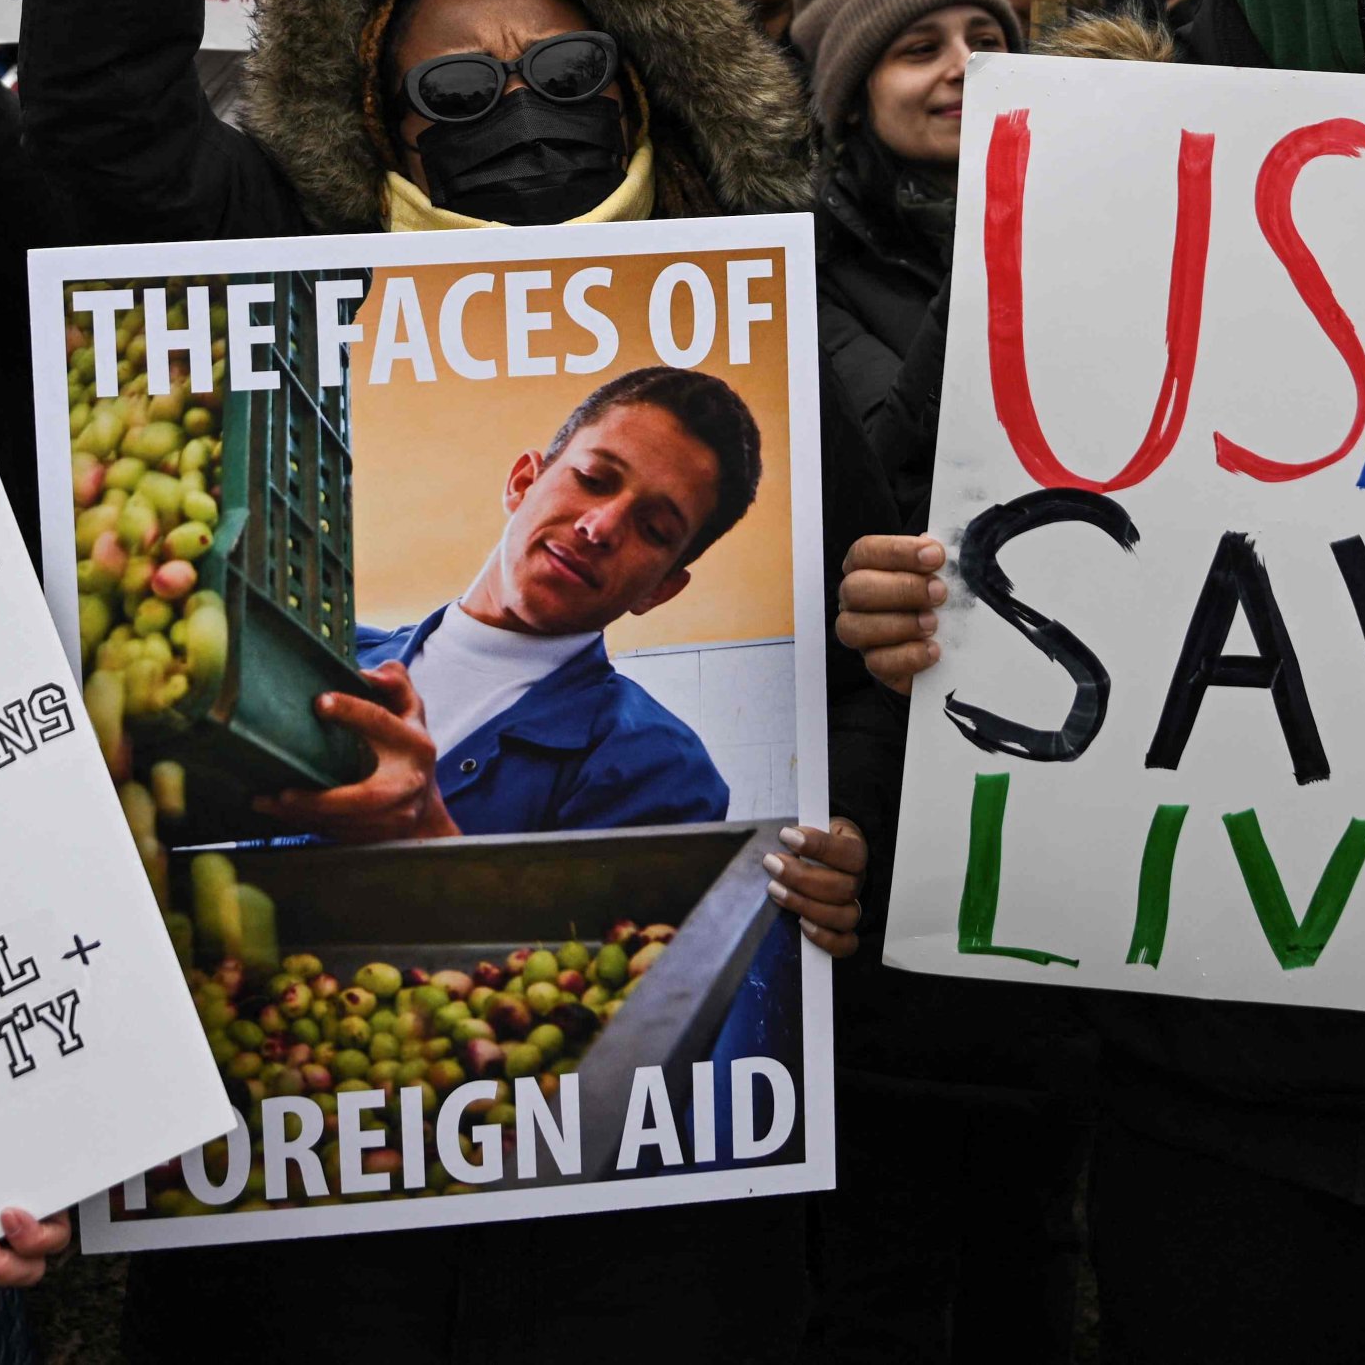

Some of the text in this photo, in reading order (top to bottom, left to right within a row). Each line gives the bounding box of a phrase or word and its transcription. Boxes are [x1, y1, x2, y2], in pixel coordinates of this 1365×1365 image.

[72, 257, 773, 399] THE FACES OF
[615, 1055, 797, 1171] AID
